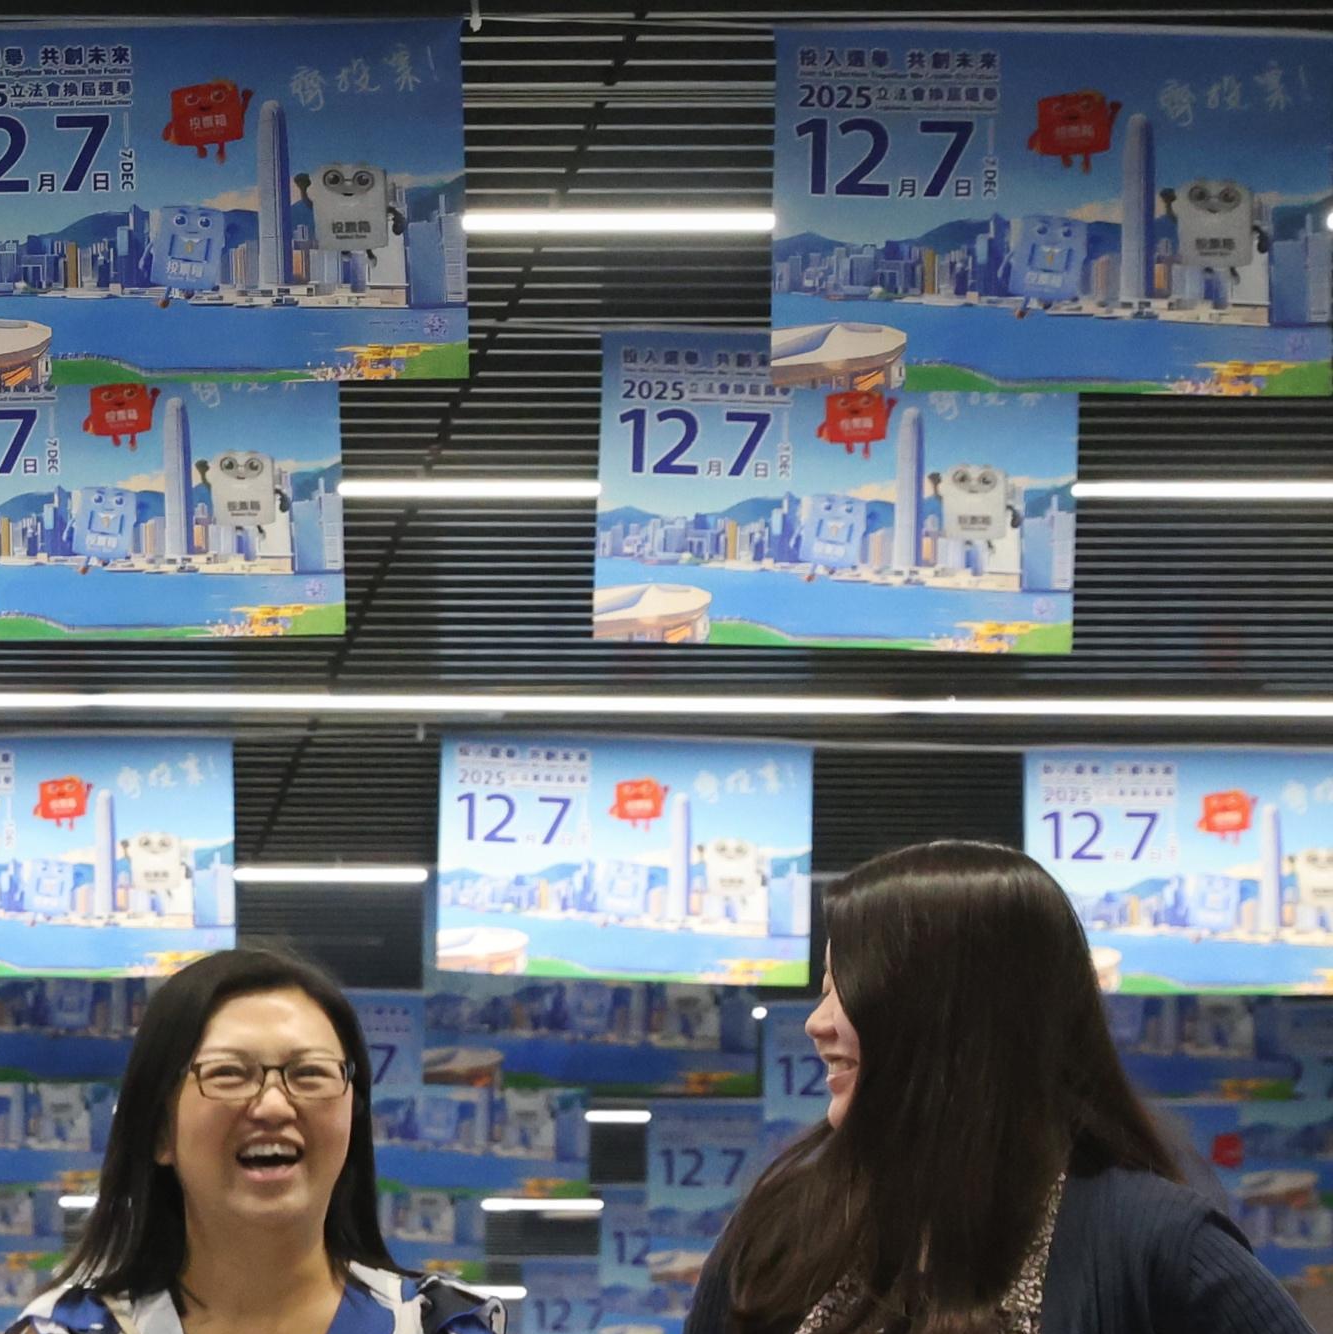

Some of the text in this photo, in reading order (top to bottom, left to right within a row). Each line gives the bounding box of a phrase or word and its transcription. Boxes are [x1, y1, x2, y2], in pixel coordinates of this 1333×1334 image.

[41, 45, 129, 65] 共創未來
[11, 81, 131, 98] 立法會換屆選舉
[798, 86, 872, 109] 2025
[121, 161, 135, 190] DEC
[622, 381, 685, 401] 2025
[47, 449, 59, 473] DEC
